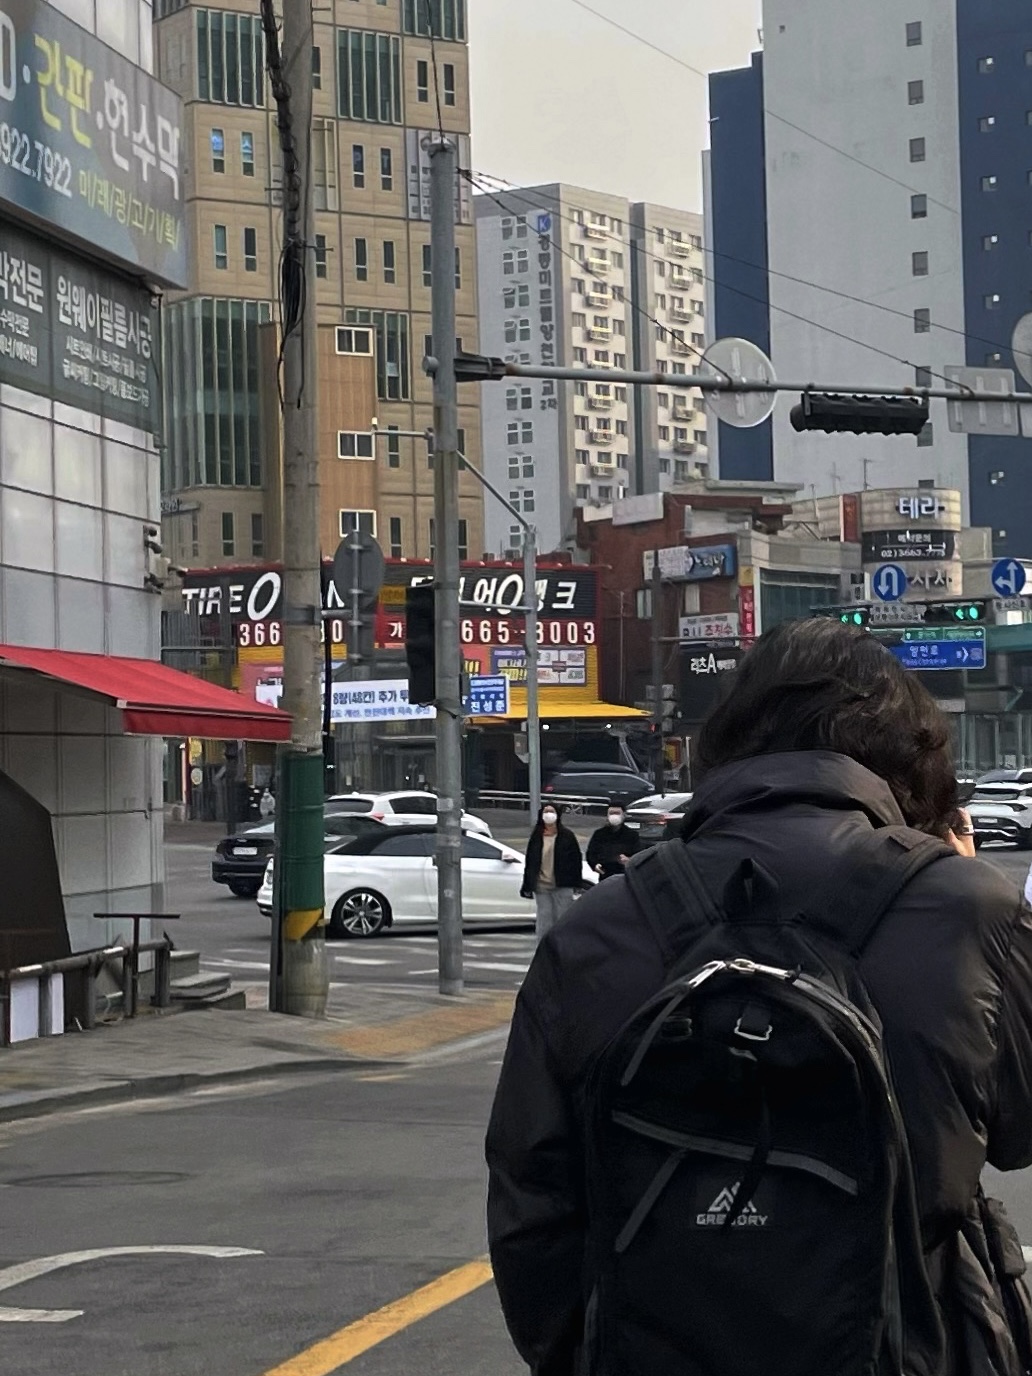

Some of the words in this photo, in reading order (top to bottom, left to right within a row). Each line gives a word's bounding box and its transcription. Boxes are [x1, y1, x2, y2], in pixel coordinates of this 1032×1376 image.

[57, 275, 152, 359] 원웨이필름시공
[899, 497, 944, 519] 테라
[378, 690, 397, 703] 추가
